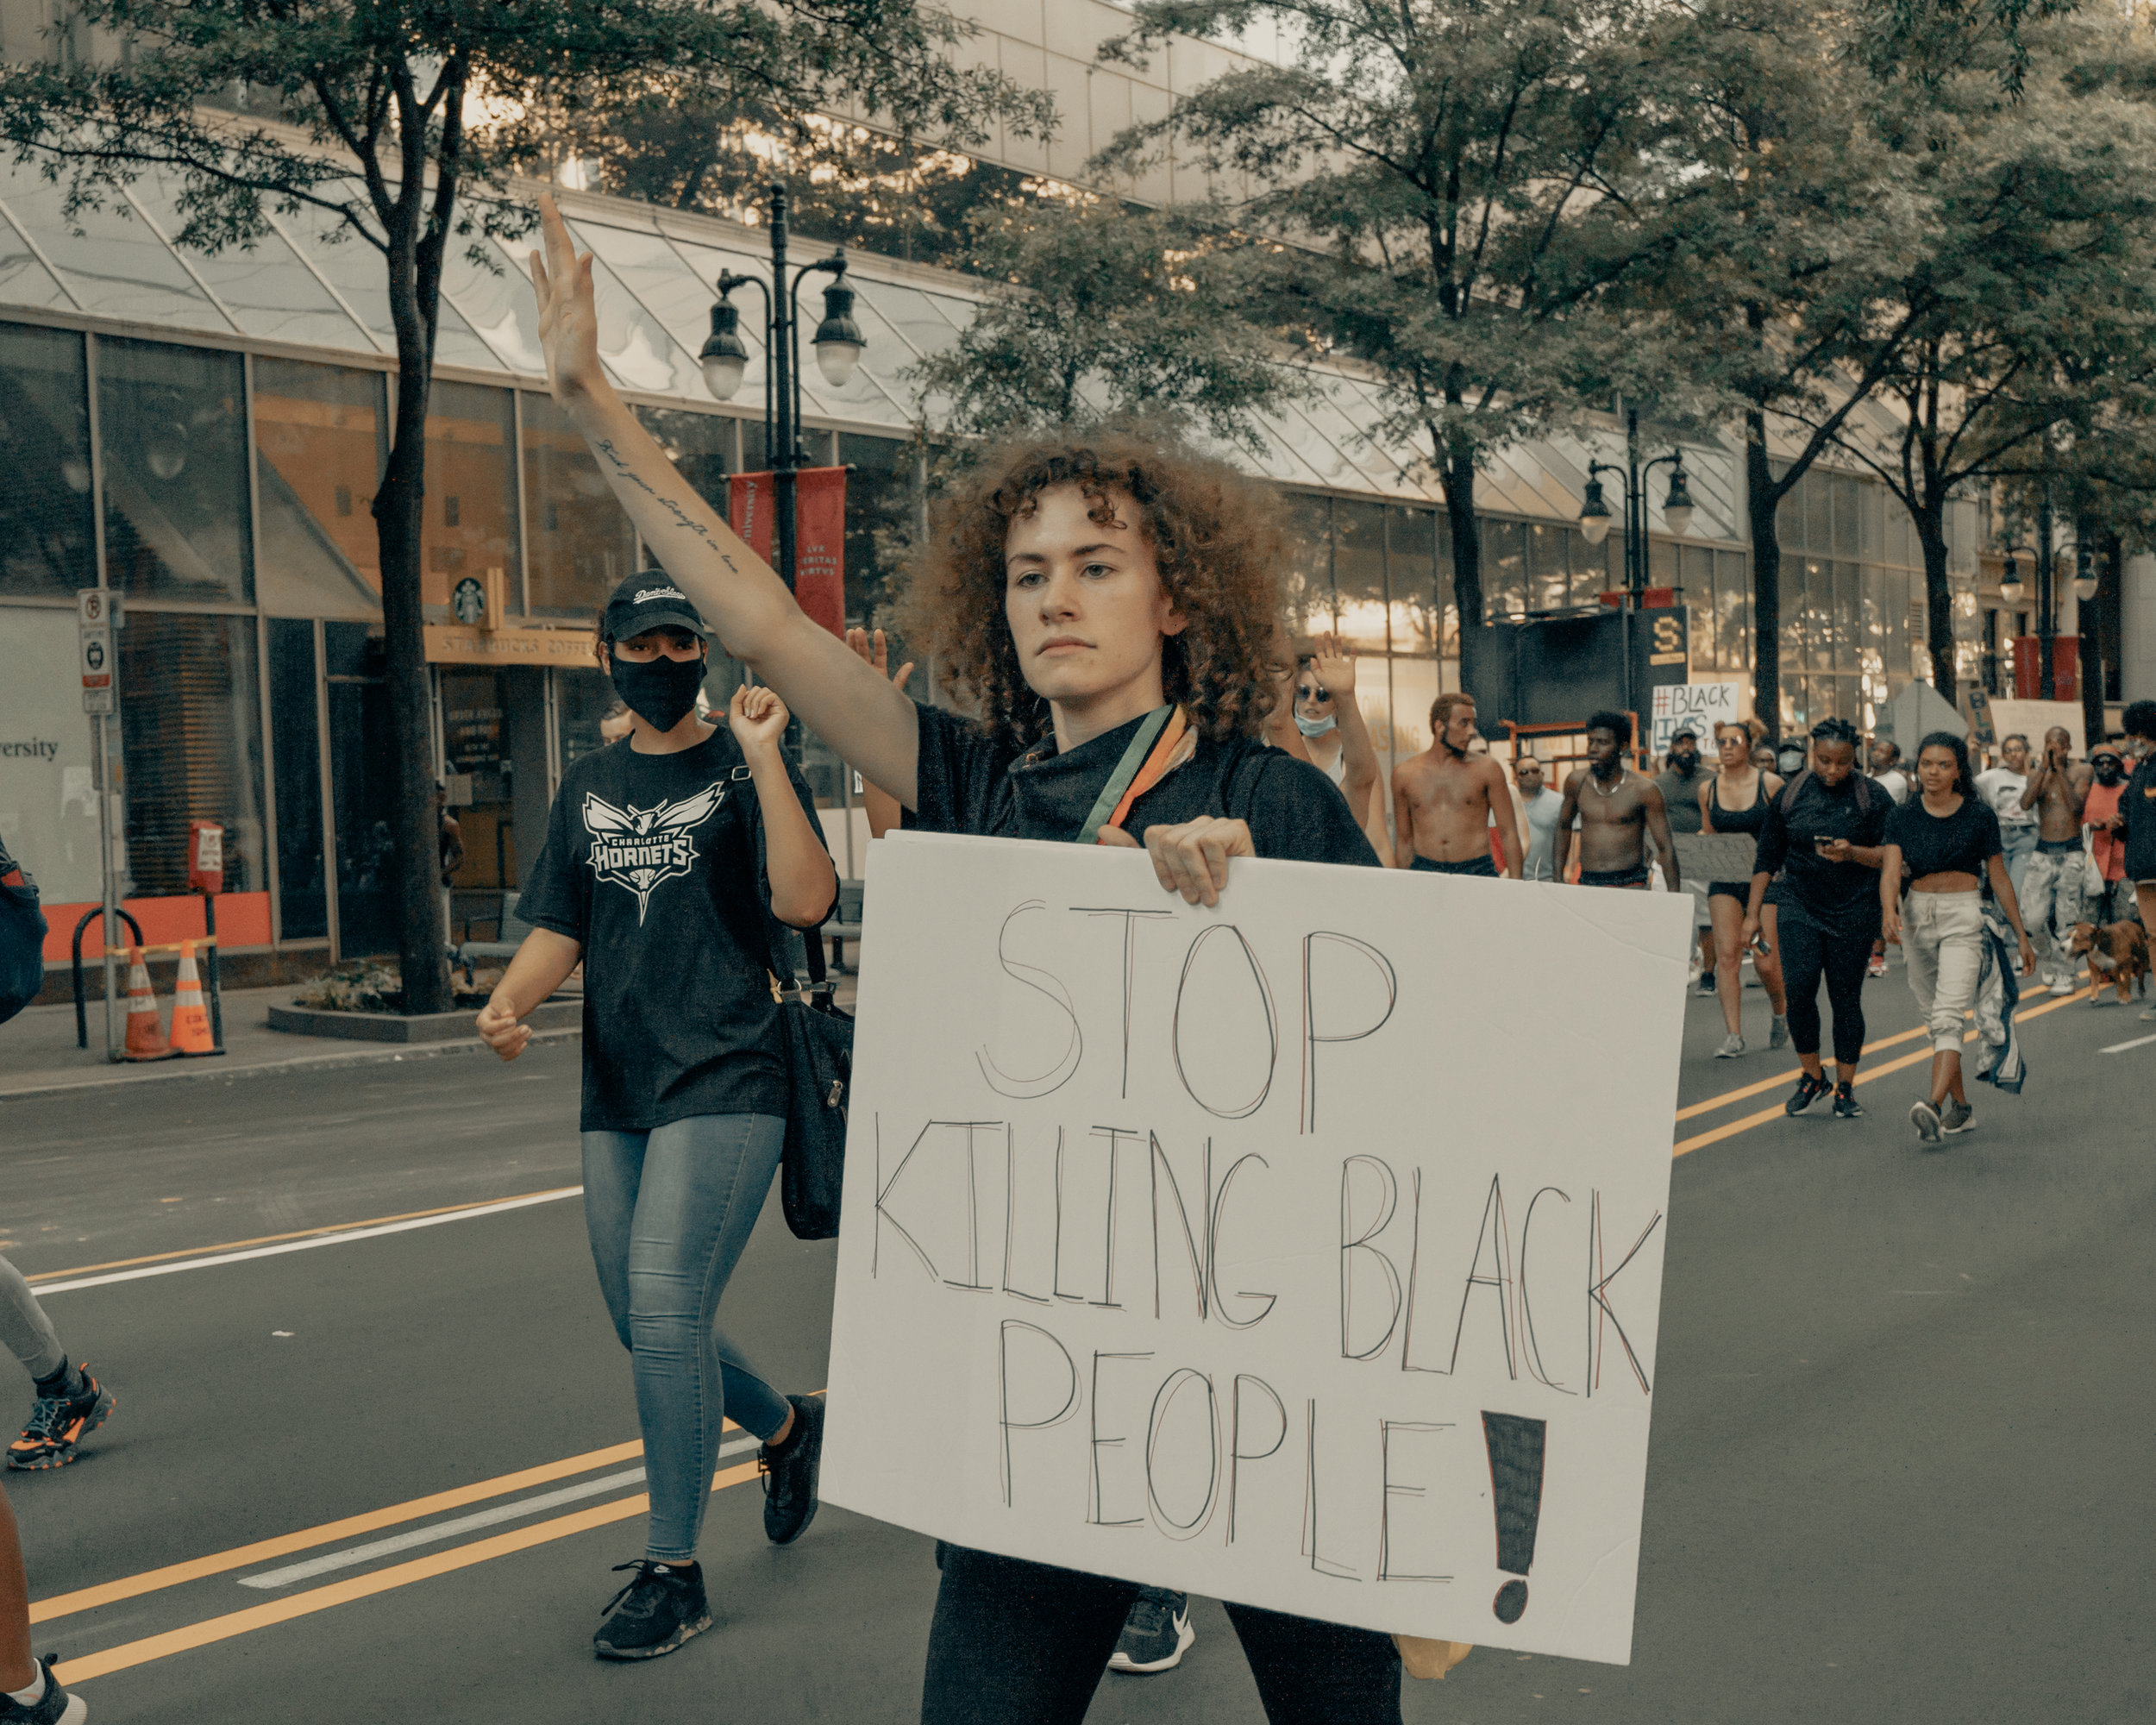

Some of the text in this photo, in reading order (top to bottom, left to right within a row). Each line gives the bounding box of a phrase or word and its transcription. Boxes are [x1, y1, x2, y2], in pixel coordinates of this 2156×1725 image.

[442, 636, 539, 655] STARBUCKS
[1655, 685, 1730, 716] #BLACK
[0, 737, 59, 762] ersity
[594, 839, 691, 873] HORNETS
[611, 834, 670, 847] CHARLOTTE
[975, 899, 1397, 1135] STOP
[873, 1111, 1663, 1398] KILLING BLACK
[999, 1320, 1548, 1625] PEOPLE!
